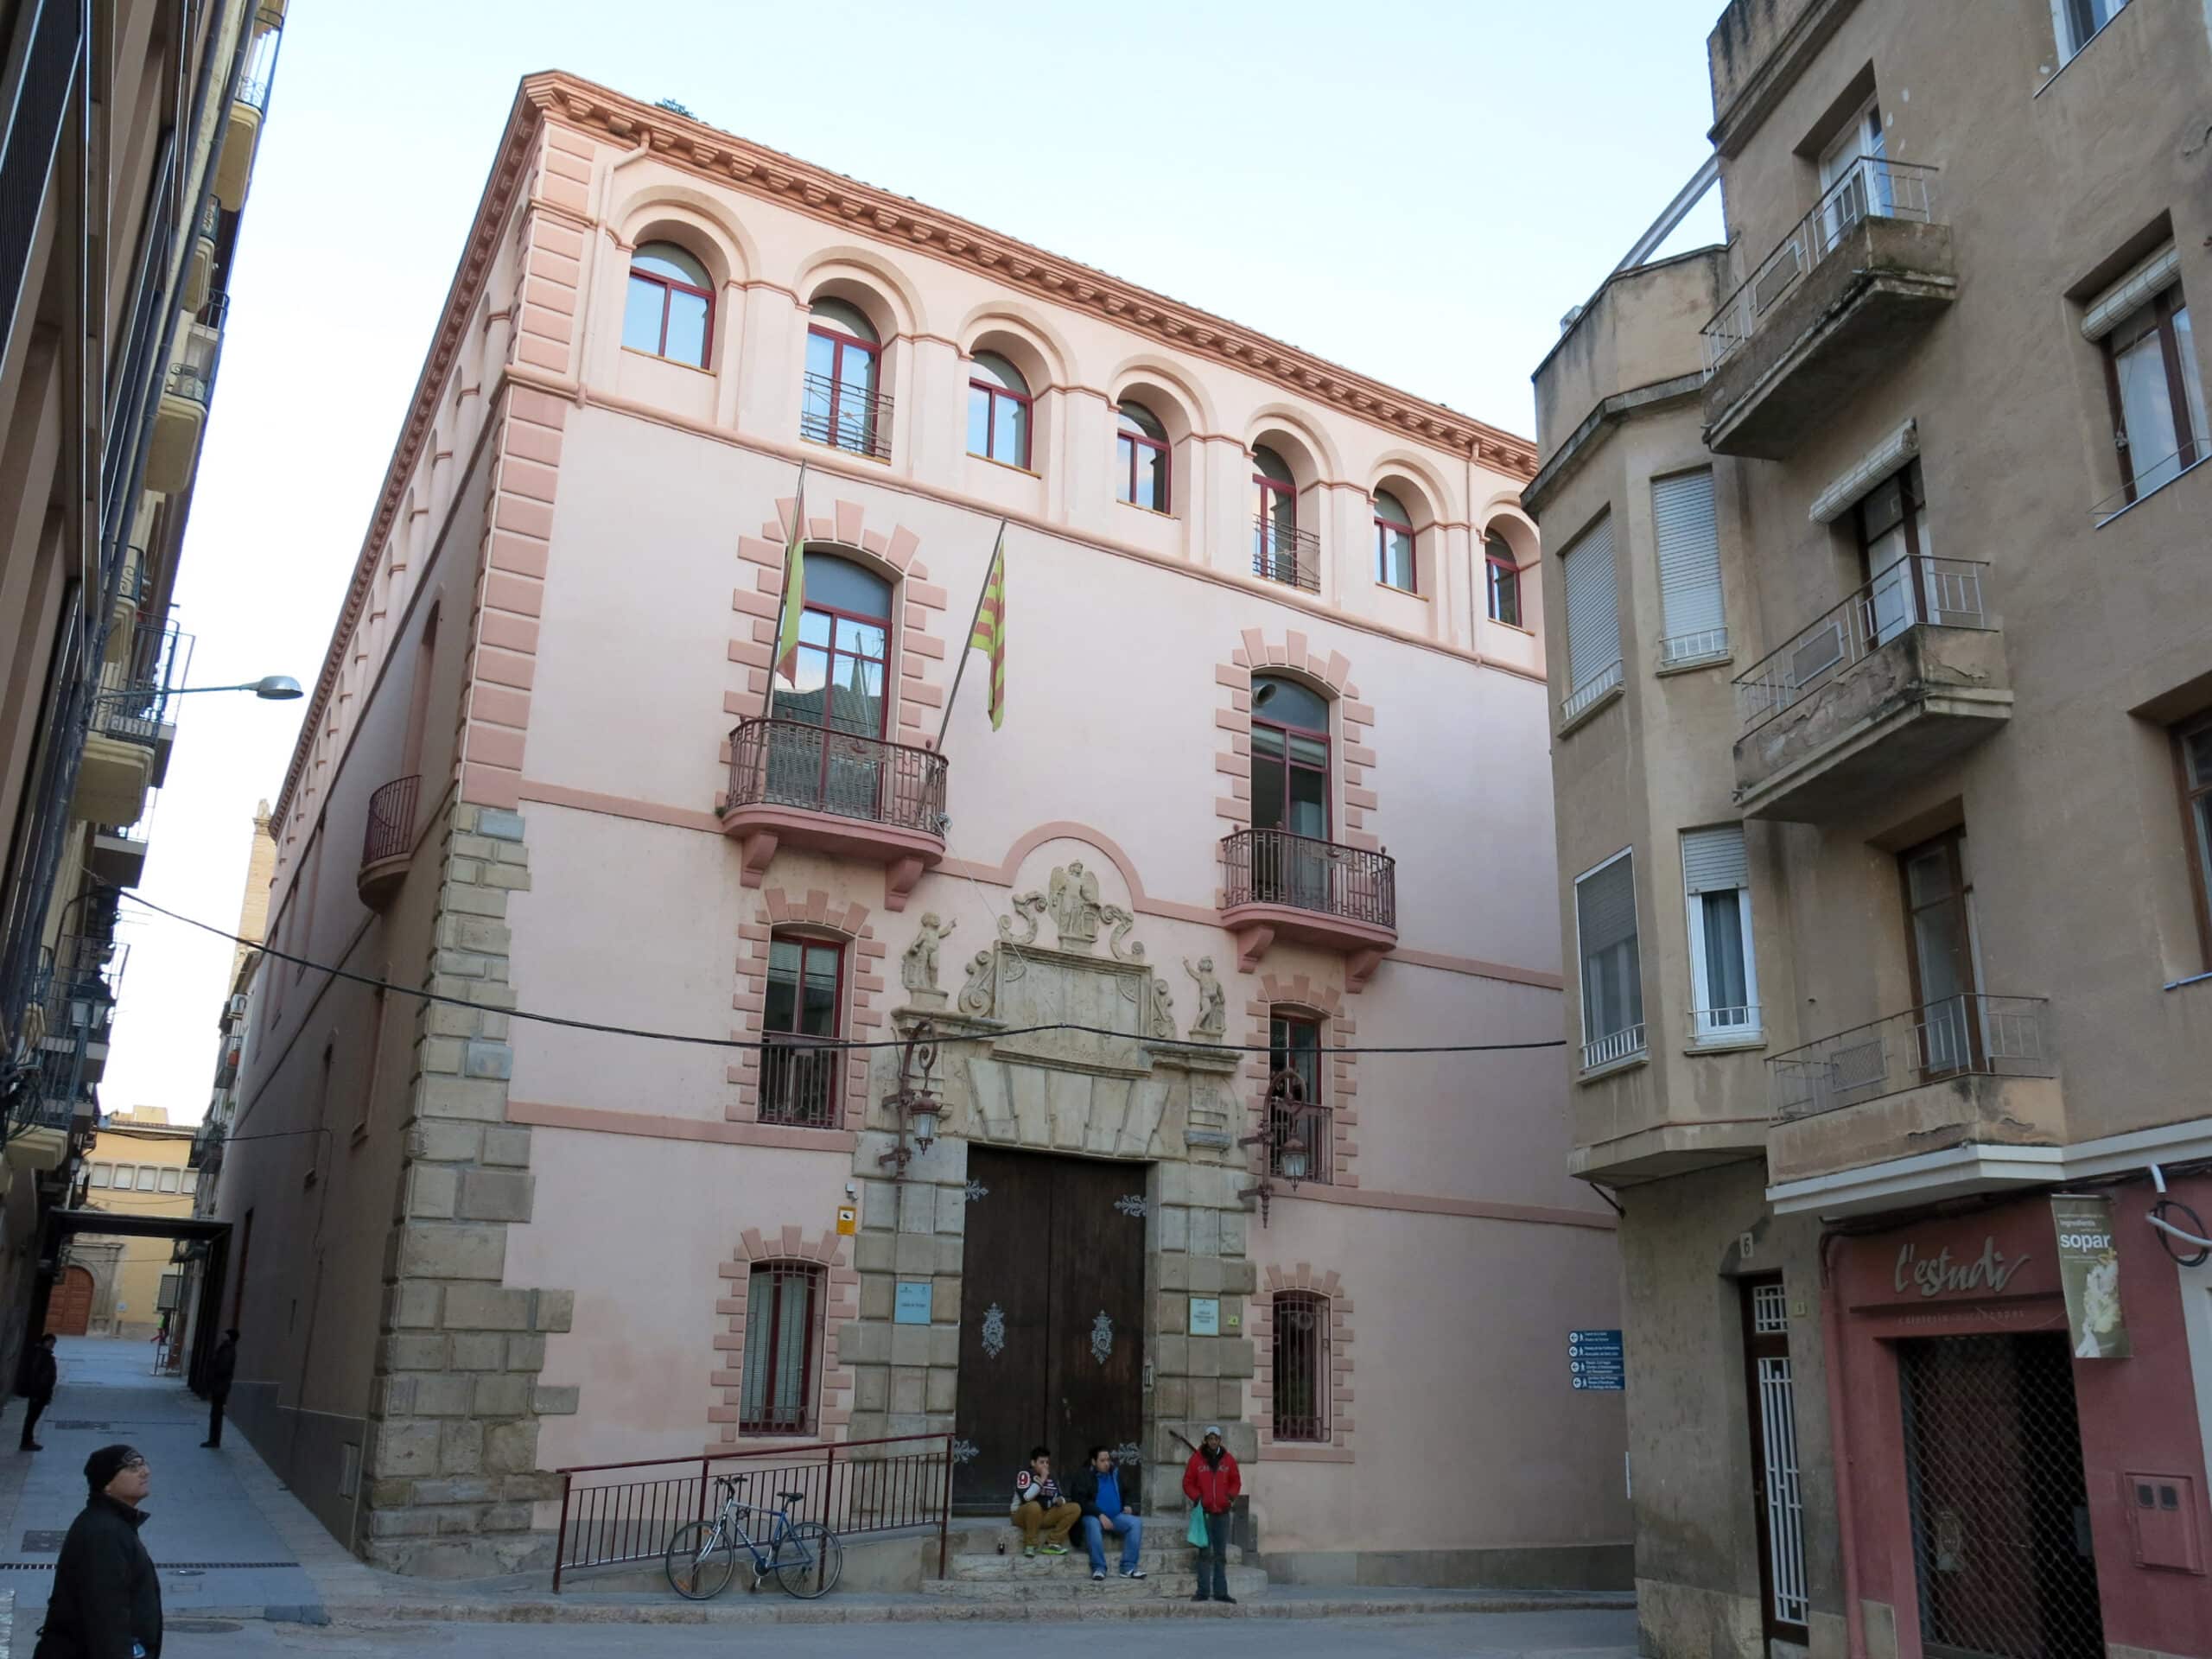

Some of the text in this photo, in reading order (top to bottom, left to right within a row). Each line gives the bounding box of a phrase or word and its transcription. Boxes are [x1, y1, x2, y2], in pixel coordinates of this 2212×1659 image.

[1744, 1236, 1751, 1255] 6
[2060, 1234, 2111, 1253] sopar
[1895, 1236, 2031, 1297] l'estudi
[1017, 1471, 1031, 1489] 9
